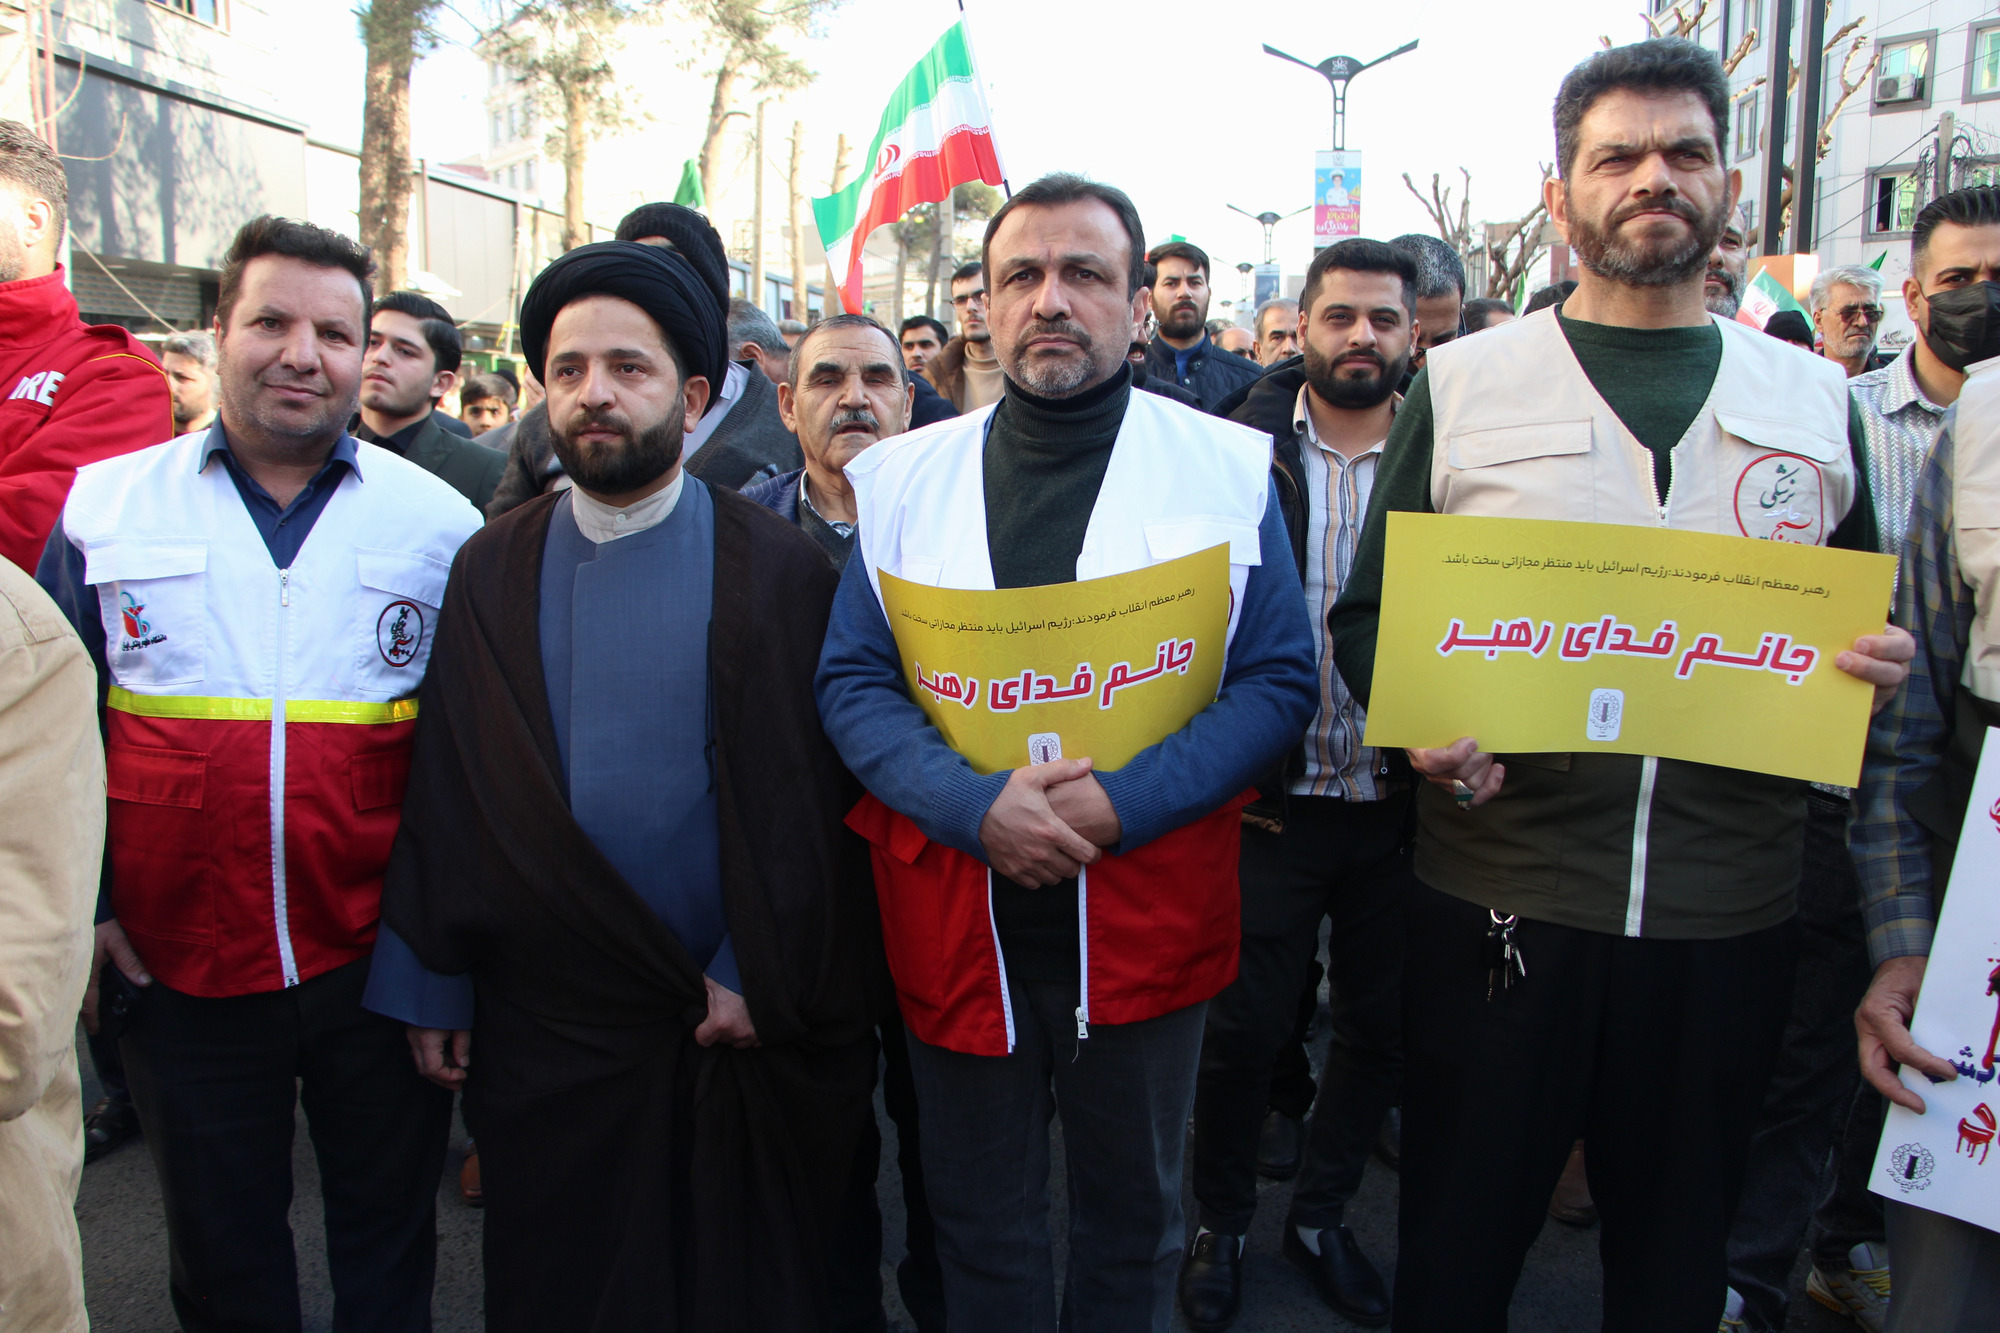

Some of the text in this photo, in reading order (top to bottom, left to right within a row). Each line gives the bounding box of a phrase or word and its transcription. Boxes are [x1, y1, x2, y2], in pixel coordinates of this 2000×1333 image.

[7, 370, 66, 407] IRE
[1472, 555, 1499, 565] سخت
[1501, 556, 1540, 570] مجازاتی
[1541, 558, 1572, 571] منتظر
[1574, 560, 1594, 573] باید
[1597, 560, 1639, 575] اسرائیل
[1723, 574, 1760, 587] انقلاب
[1762, 579, 1799, 591] معظم
[1177, 588, 1195, 601] رهبر
[1801, 586, 1830, 598] رهبر
[1119, 600, 1148, 617] انقلاب
[1149, 595, 1176, 610] معظم
[929, 619, 956, 631] مجازاتی
[957, 621, 984, 633] منتظر
[986, 622, 1004, 634] باید
[1006, 620, 1045, 634] اسرائیل
[1437, 616, 1817, 686] جانم فدای رهبر
[915, 638, 1196, 712] جانم فدای رهبر
